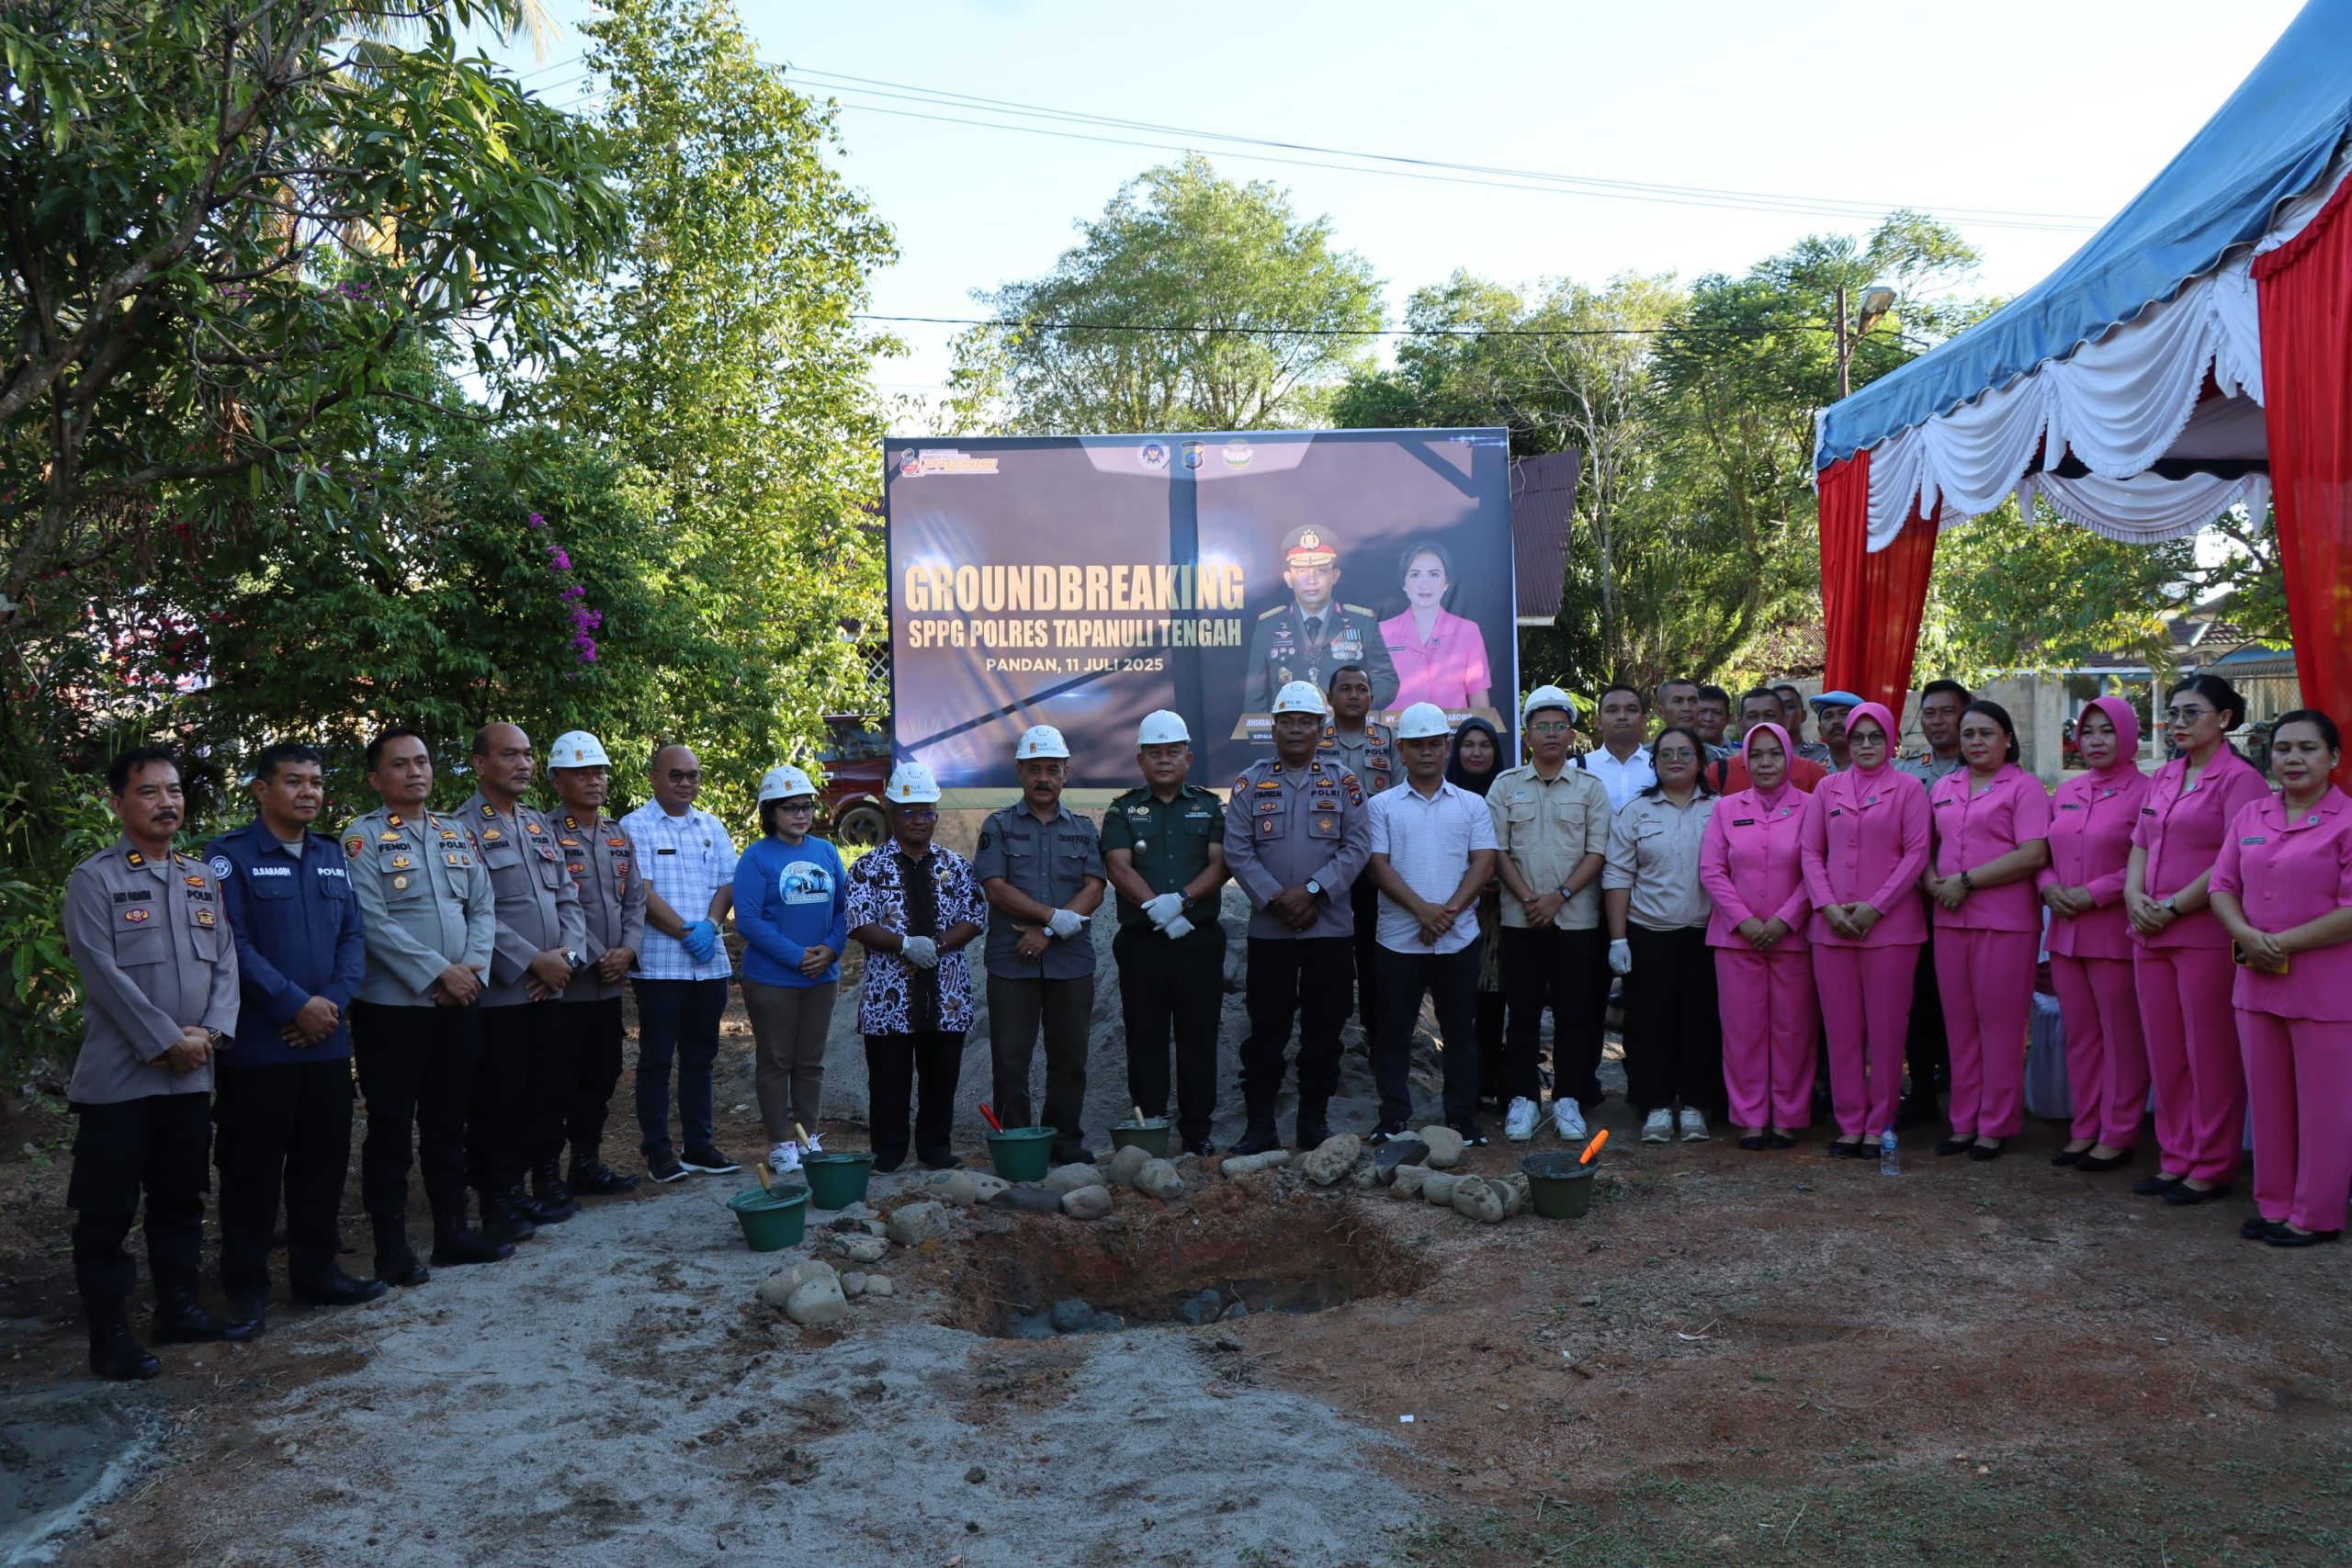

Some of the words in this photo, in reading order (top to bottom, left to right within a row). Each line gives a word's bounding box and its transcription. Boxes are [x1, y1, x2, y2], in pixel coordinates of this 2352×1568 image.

[905, 565, 1244, 612] GROUNDBREAKING
[909, 619, 965, 648] SPPG
[969, 619, 1048, 648] POLRES
[1053, 619, 1154, 648] TAPANULI
[1158, 618, 1241, 647] TENGAH
[986, 658, 1061, 674] PANDAN,
[1066, 658, 1080, 671] 11
[1083, 658, 1118, 671] JULI
[1123, 658, 1164, 671] 2025
[1246, 718, 1273, 727] JENDERAL
[1385, 715, 1397, 724] NY.
[1311, 789, 1340, 797] POLRI
[439, 840, 468, 850] POLRI
[530, 836, 550, 844] POLRI
[378, 842, 413, 852] FENDI
[609, 849, 631, 858] POLRI
[252, 867, 292, 876] D.SARAGIH
[317, 867, 345, 877] POLRI
[187, 889, 213, 902] POLRI
